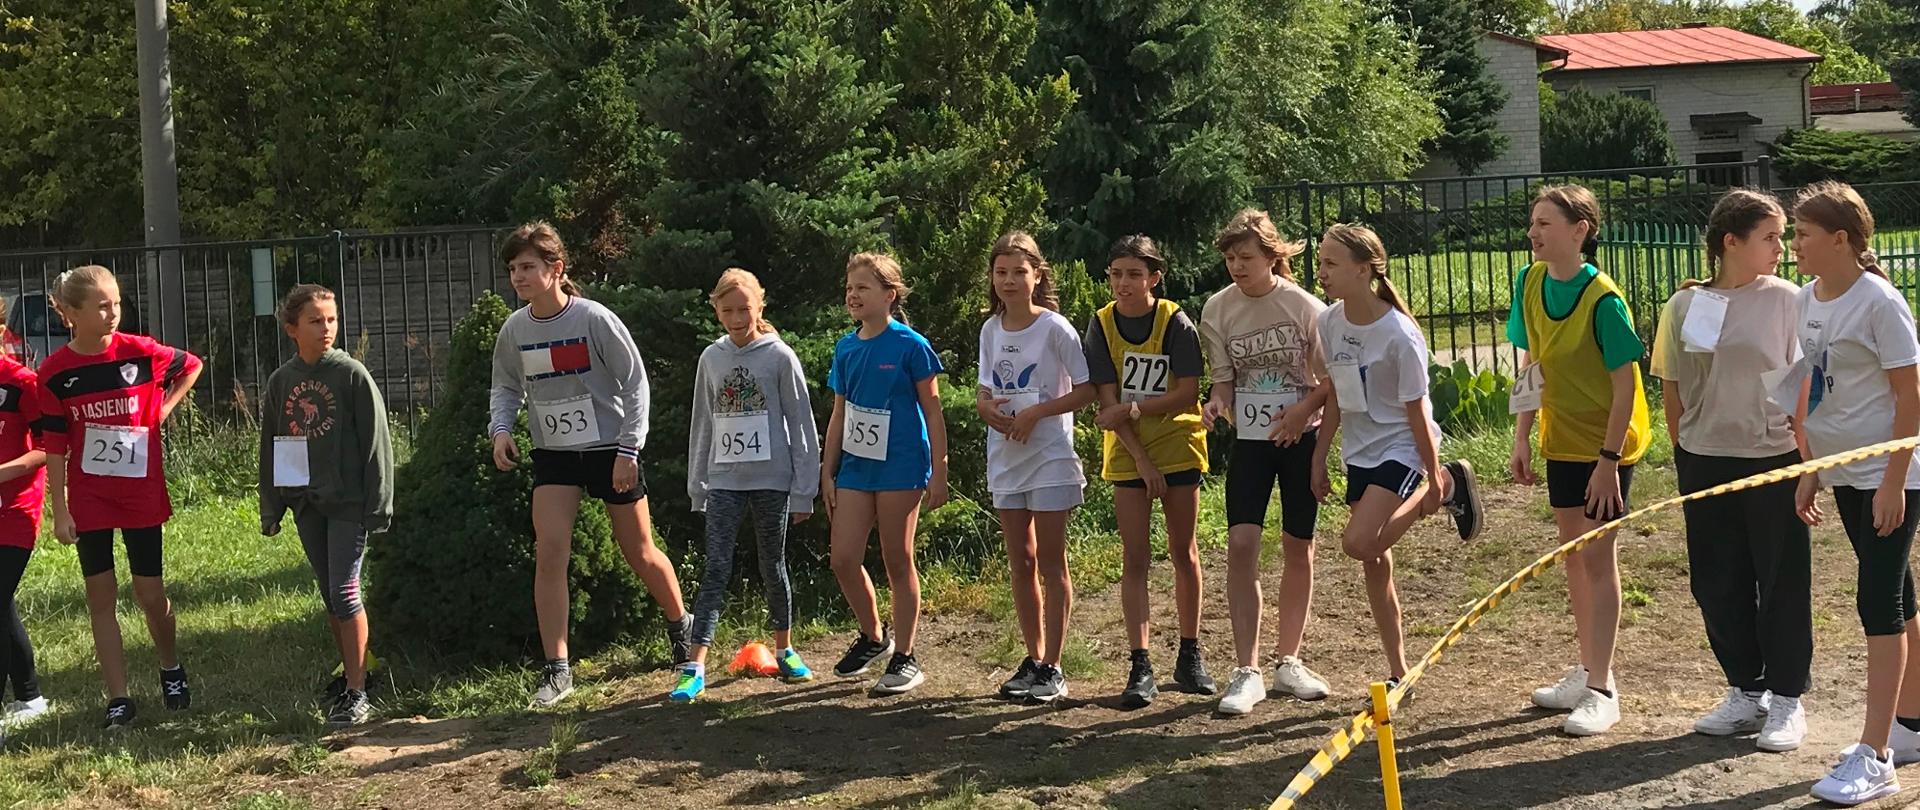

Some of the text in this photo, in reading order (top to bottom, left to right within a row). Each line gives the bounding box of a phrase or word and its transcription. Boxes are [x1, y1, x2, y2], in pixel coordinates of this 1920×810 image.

[1228, 322, 1305, 358] STAY
[1123, 355, 1168, 392] 272
[285, 380, 336, 415] ABERCROMBIE
[545, 410, 588, 435] 953
[847, 417, 880, 446] 955
[91, 438, 137, 464] 251
[721, 431, 762, 456] 954
